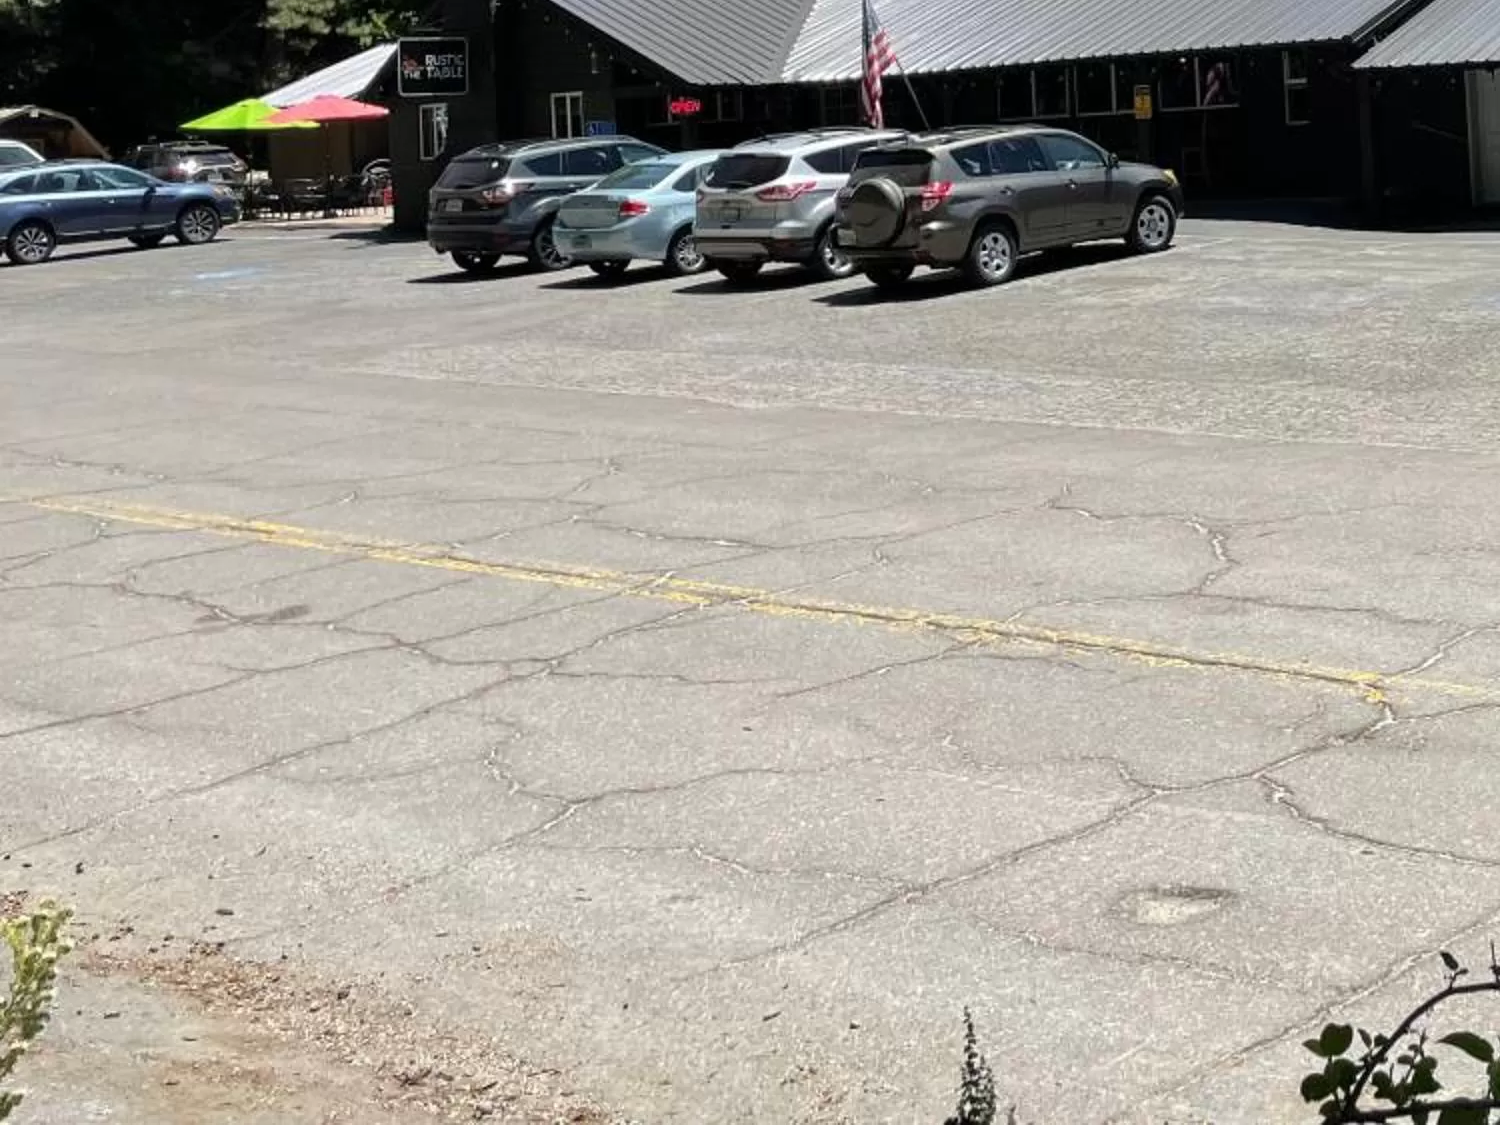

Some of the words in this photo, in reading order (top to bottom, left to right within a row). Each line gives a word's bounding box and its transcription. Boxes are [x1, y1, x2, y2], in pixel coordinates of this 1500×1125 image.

[425, 54, 465, 66] RUSTIC
[426, 66, 465, 79] TABLE
[670, 100, 701, 114] OPEN
